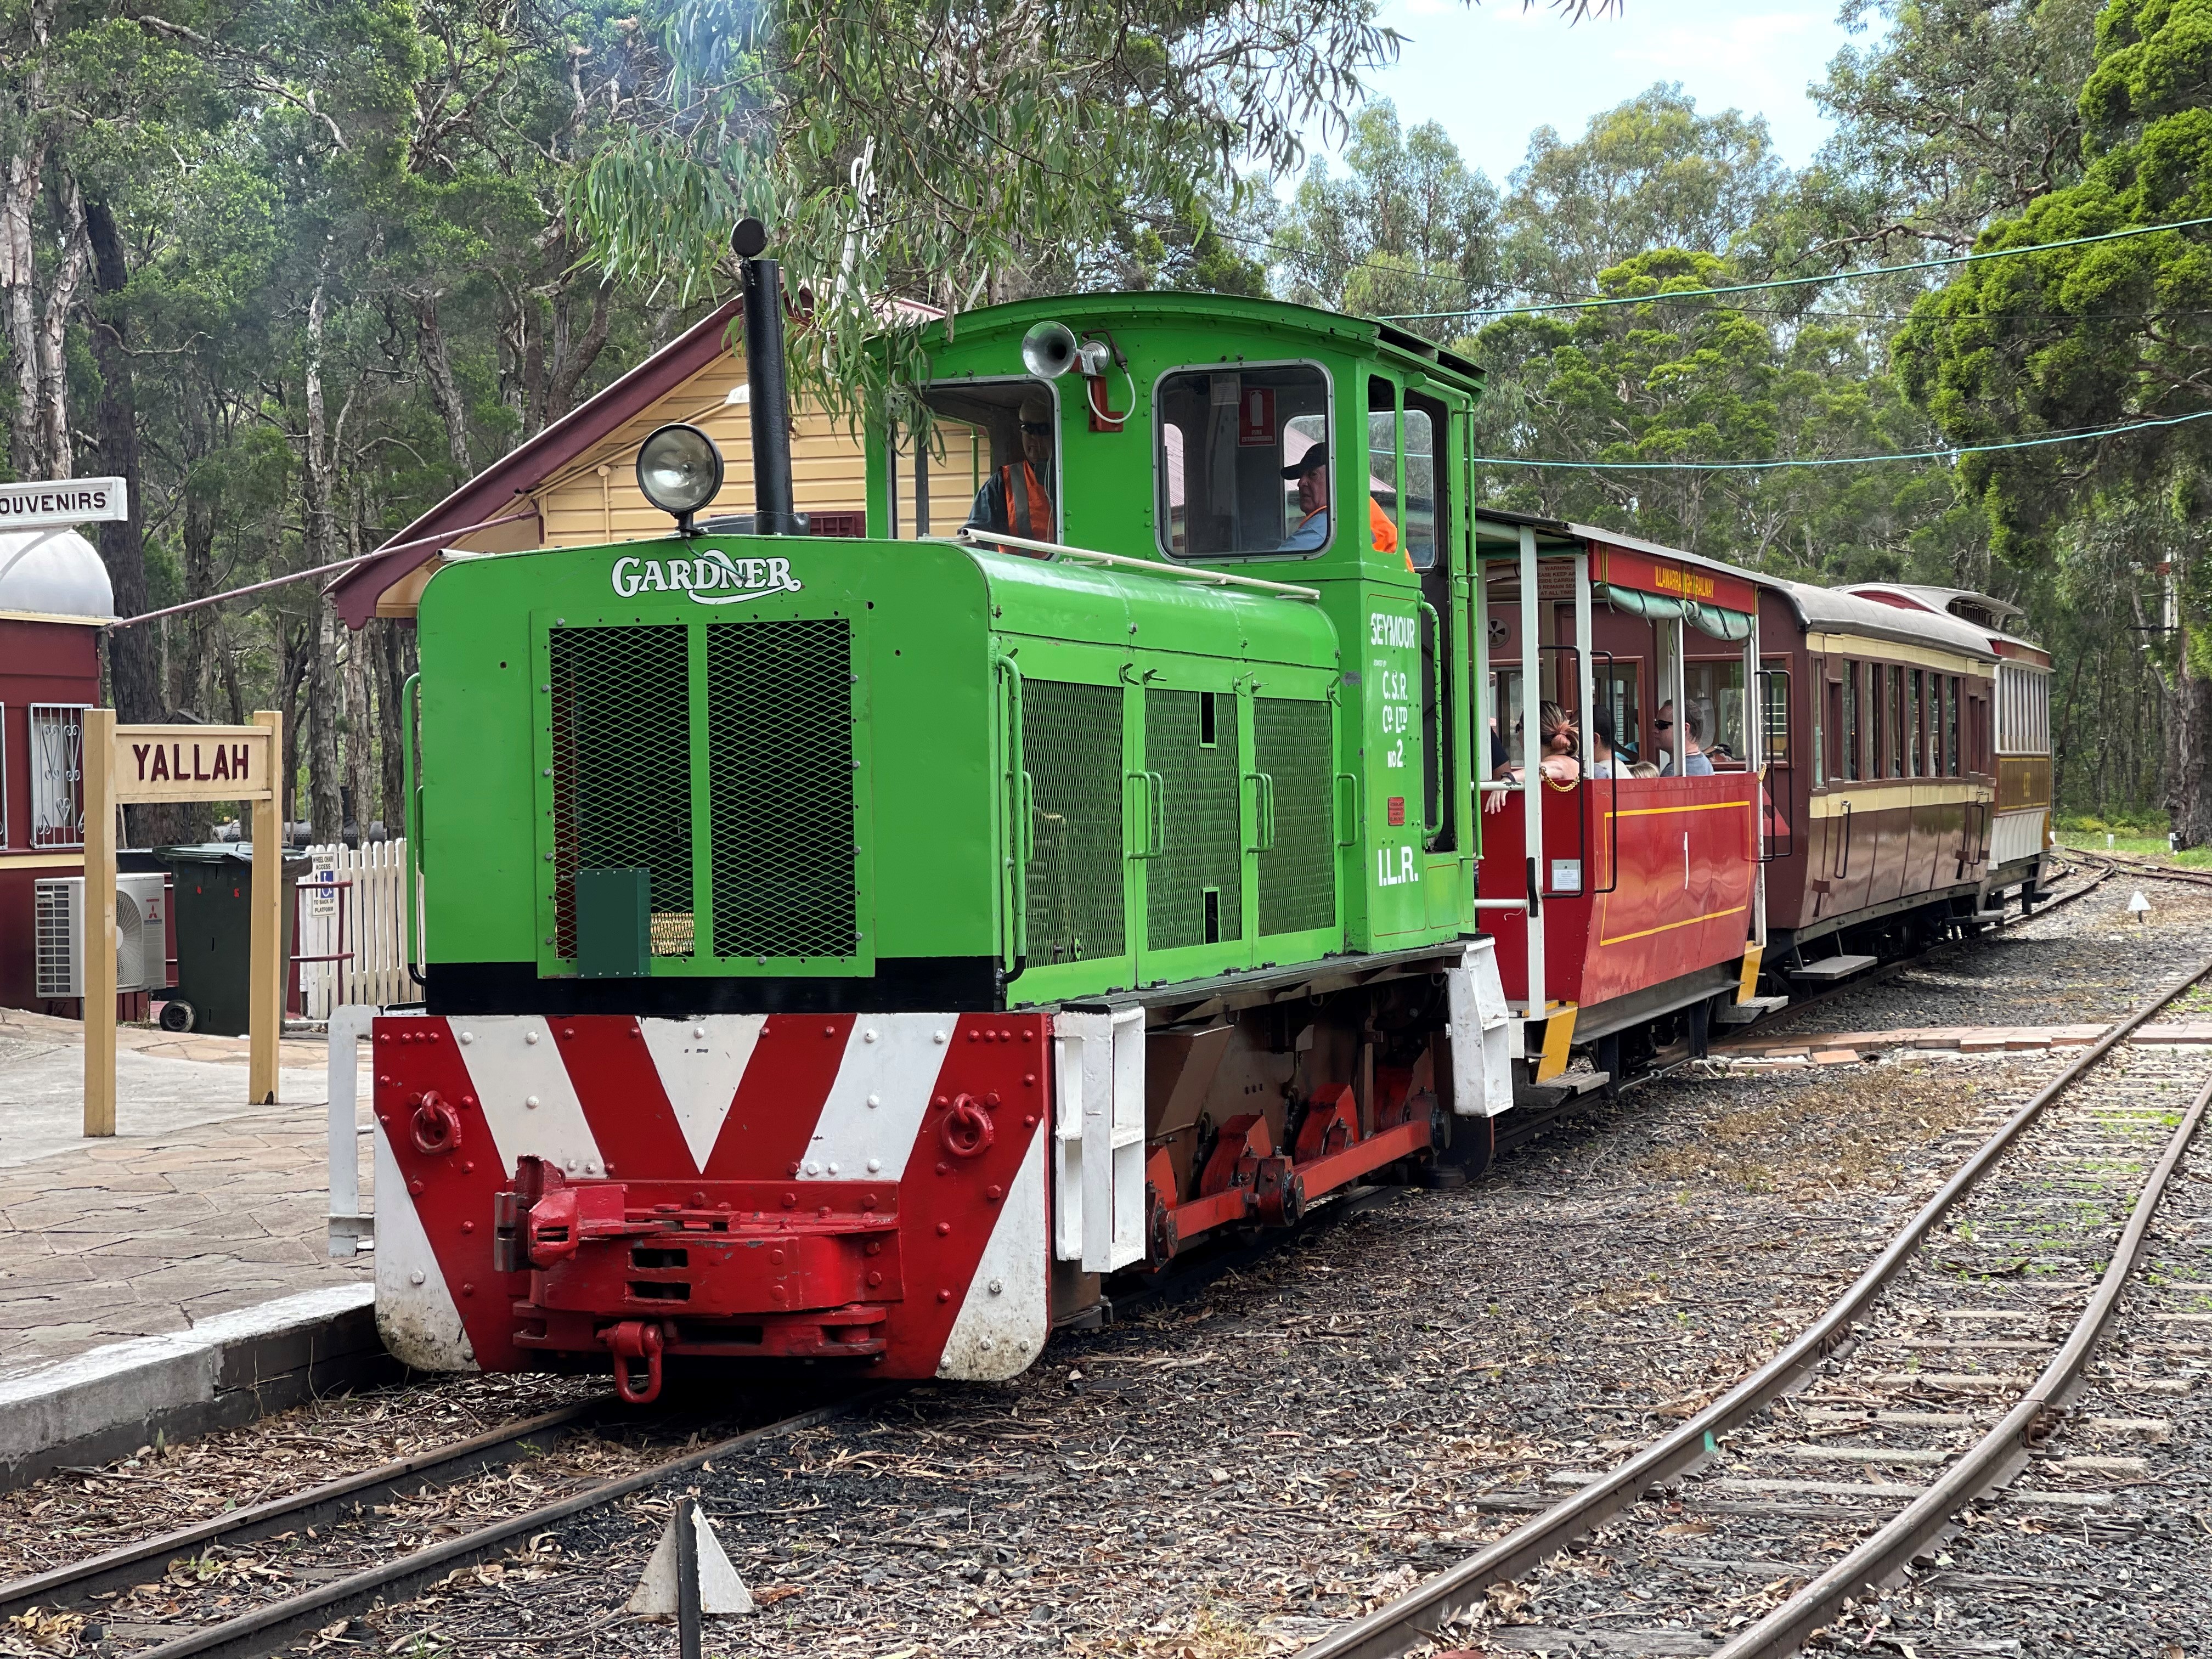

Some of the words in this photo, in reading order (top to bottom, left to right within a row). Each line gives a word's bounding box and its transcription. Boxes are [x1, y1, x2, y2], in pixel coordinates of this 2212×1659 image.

[611, 549, 803, 605] GARDNER
[1370, 612, 1415, 649] SEYMOUR
[132, 743, 249, 782] YALLAH
[1378, 846, 1419, 887] I.L.R.
